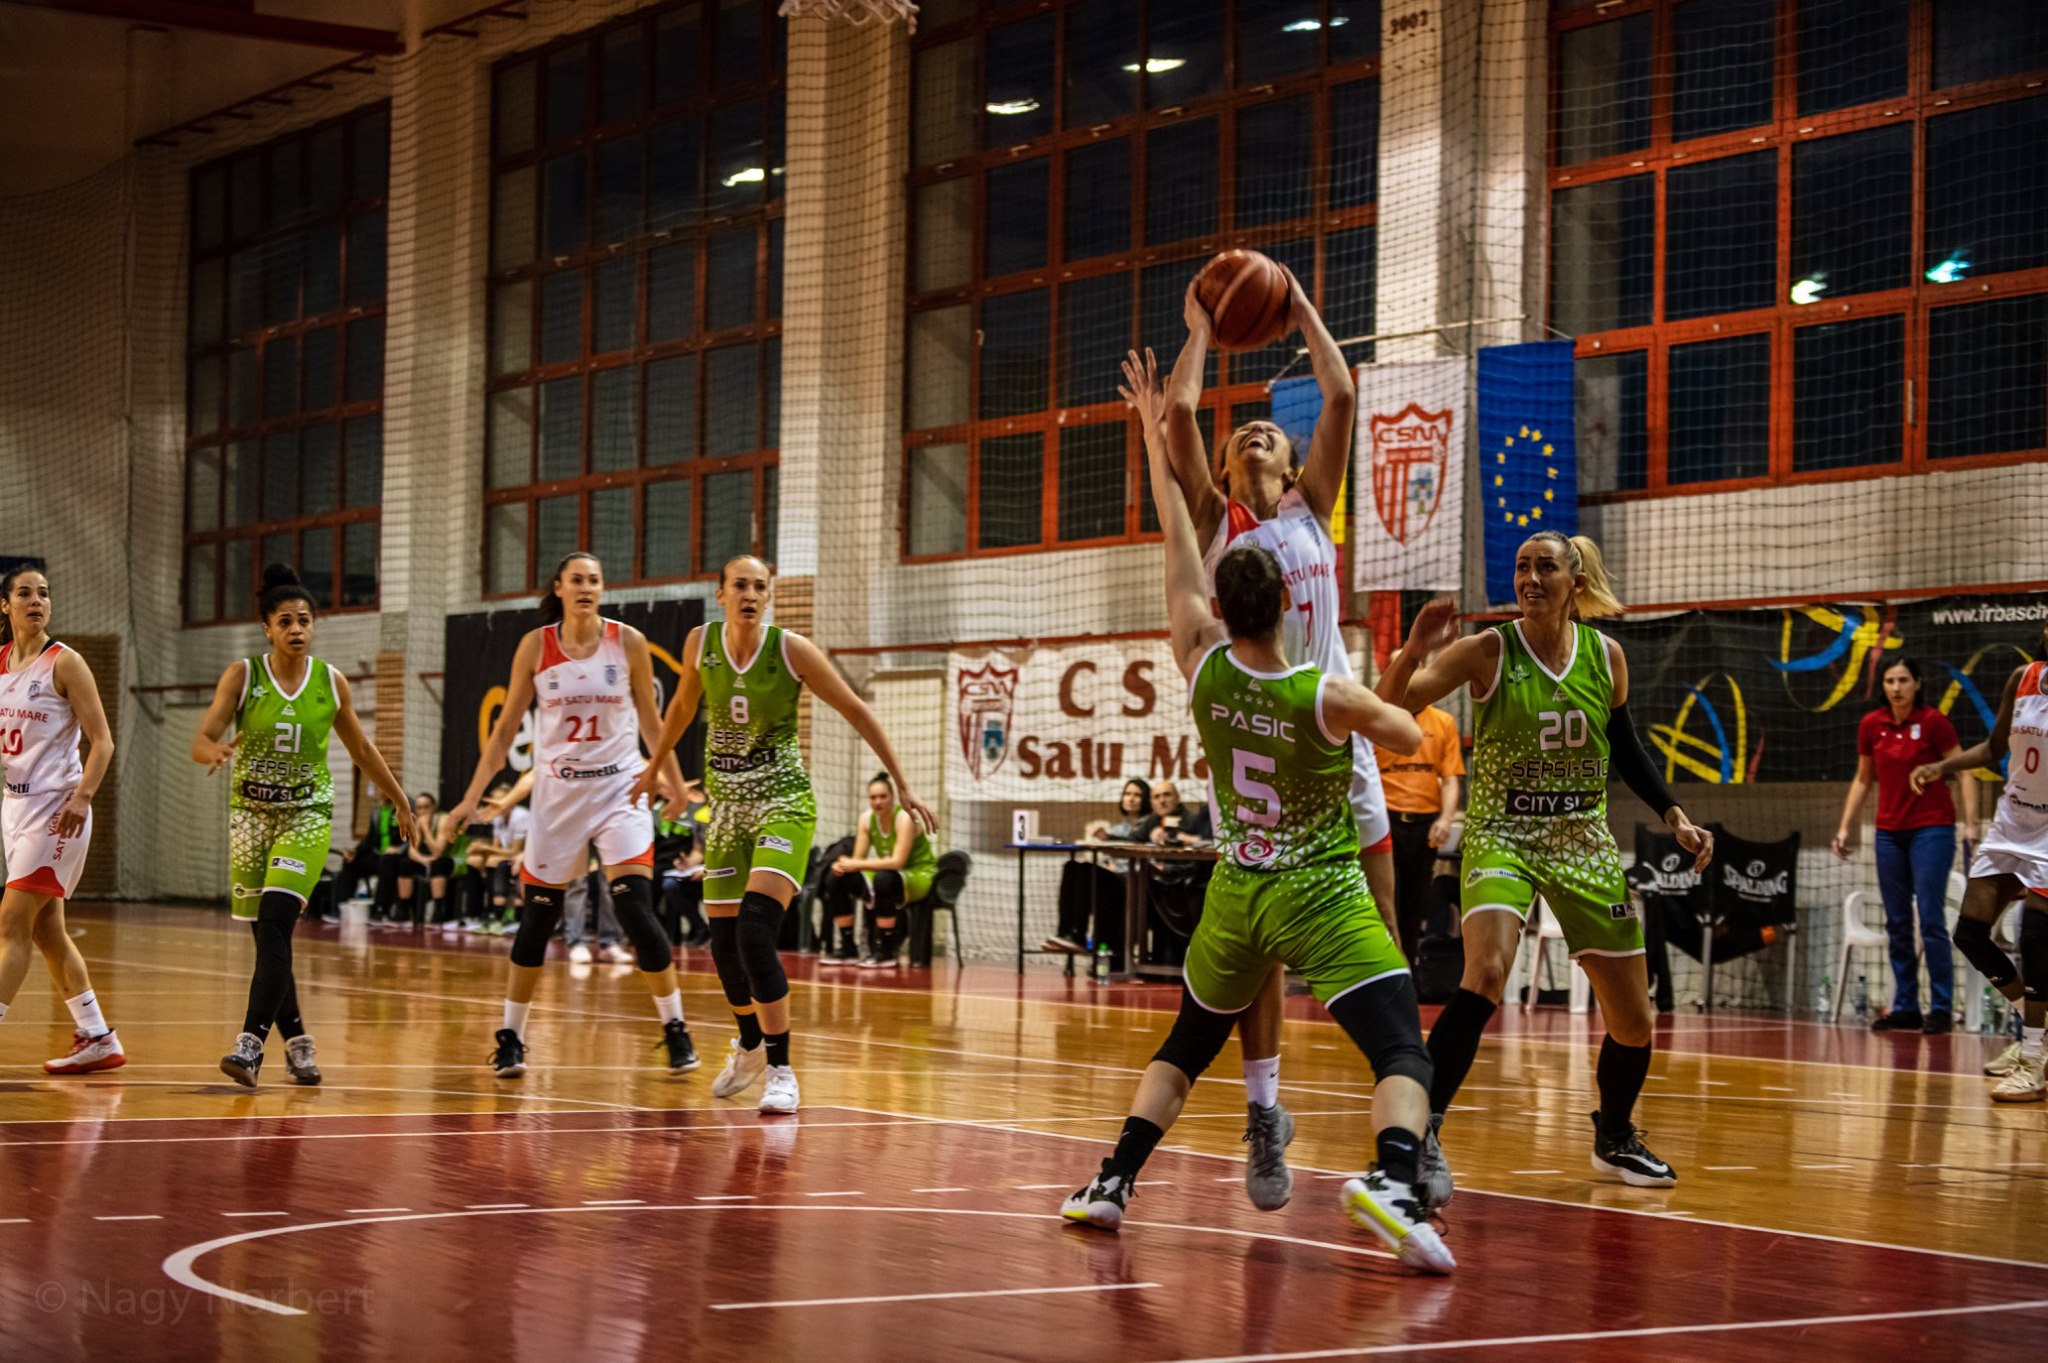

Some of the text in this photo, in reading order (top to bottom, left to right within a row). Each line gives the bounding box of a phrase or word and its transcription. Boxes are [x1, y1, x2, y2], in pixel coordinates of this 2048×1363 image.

[1378, 425, 1442, 444] CSM
[1283, 567, 1307, 587] ATU
[1298, 601, 1313, 646] 7
[564, 694, 593, 706] SATU
[730, 695, 750, 724] 8
[0, 707, 49, 723] ATU MARE
[565, 715, 603, 743] 21
[1211, 703, 1296, 743] PASIC
[274, 722, 302, 753] 21
[1539, 709, 1588, 751] 20
[2020, 724, 2043, 738] SATU
[1017, 735, 1209, 780] Satu Ma
[2025, 746, 2040, 774] 0
[247, 785, 279, 799] CITY
[1231, 747, 1282, 828] 5
[1514, 794, 1559, 813] CITY
[1018, 814, 1026, 841] 3
[53, 838, 66, 862] SAT
[1723, 863, 1789, 896] SPALDING
